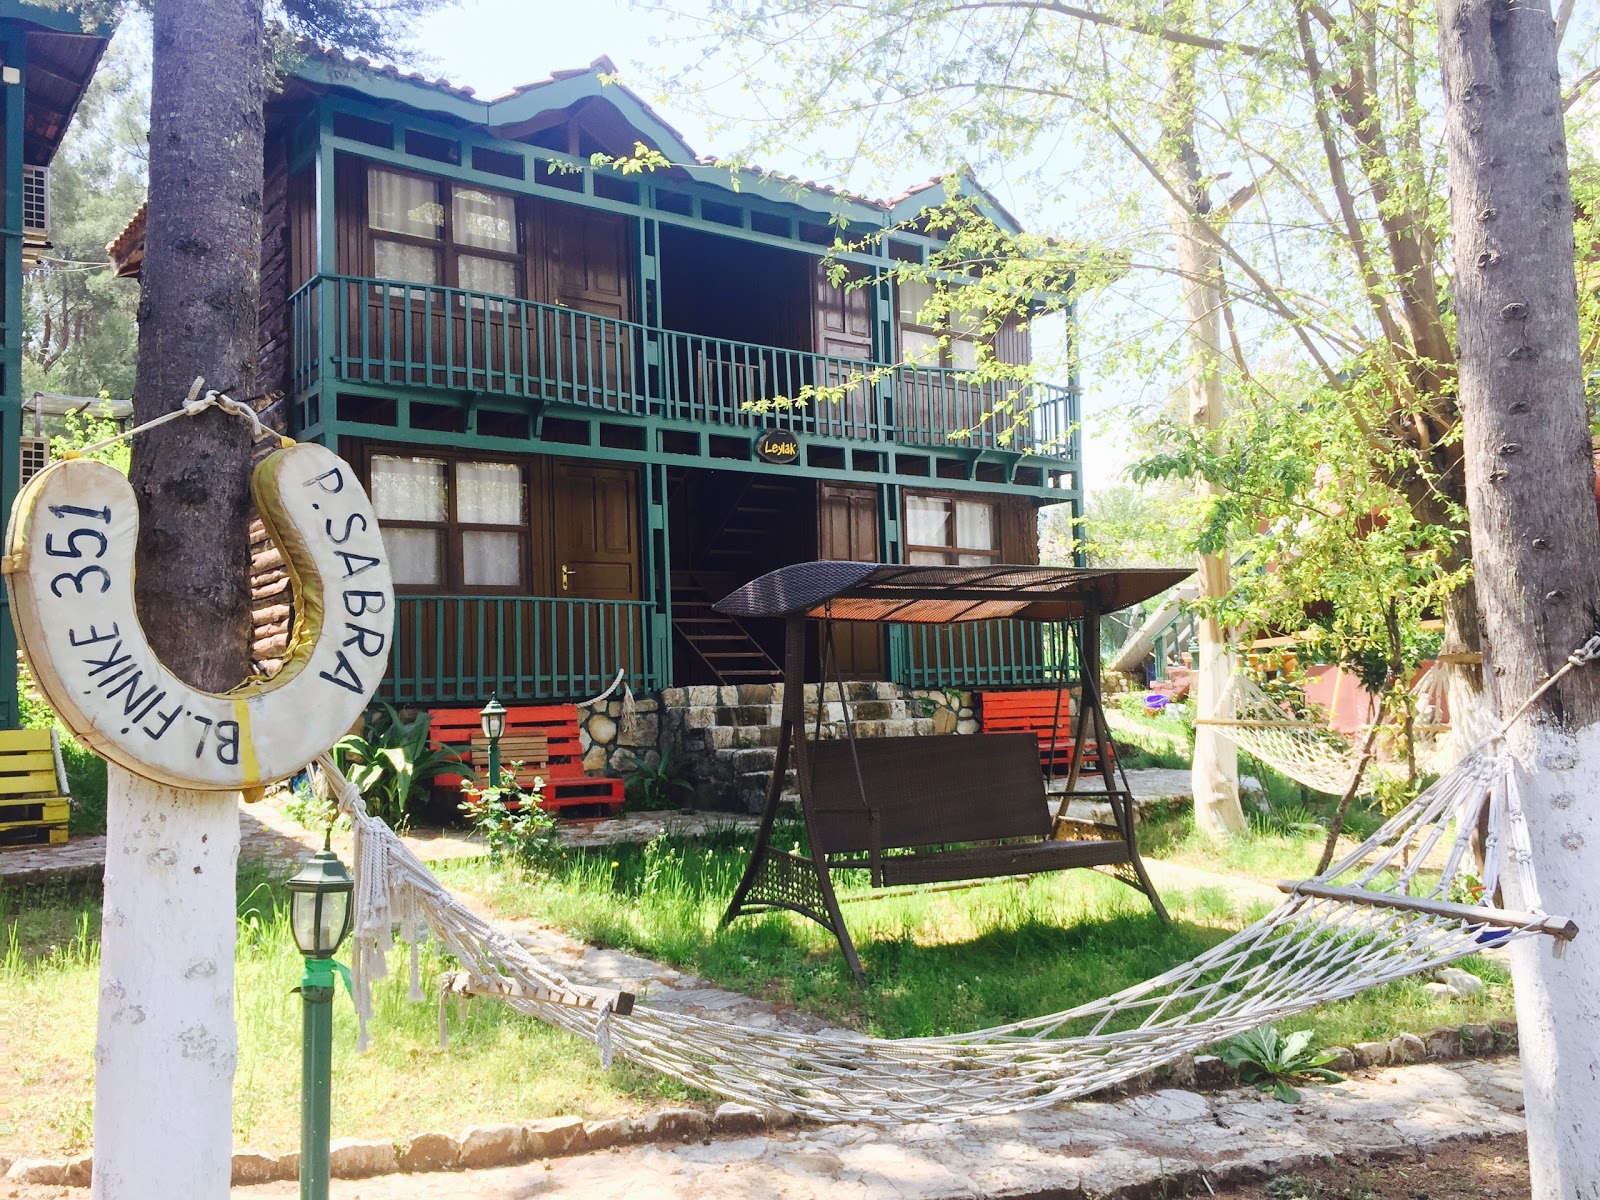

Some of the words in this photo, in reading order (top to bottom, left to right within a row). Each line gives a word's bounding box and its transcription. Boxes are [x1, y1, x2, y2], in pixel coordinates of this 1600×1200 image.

[765, 441, 797, 455] Leylak
[45, 503, 112, 598] 351
[302, 467, 386, 695] P.SABRA
